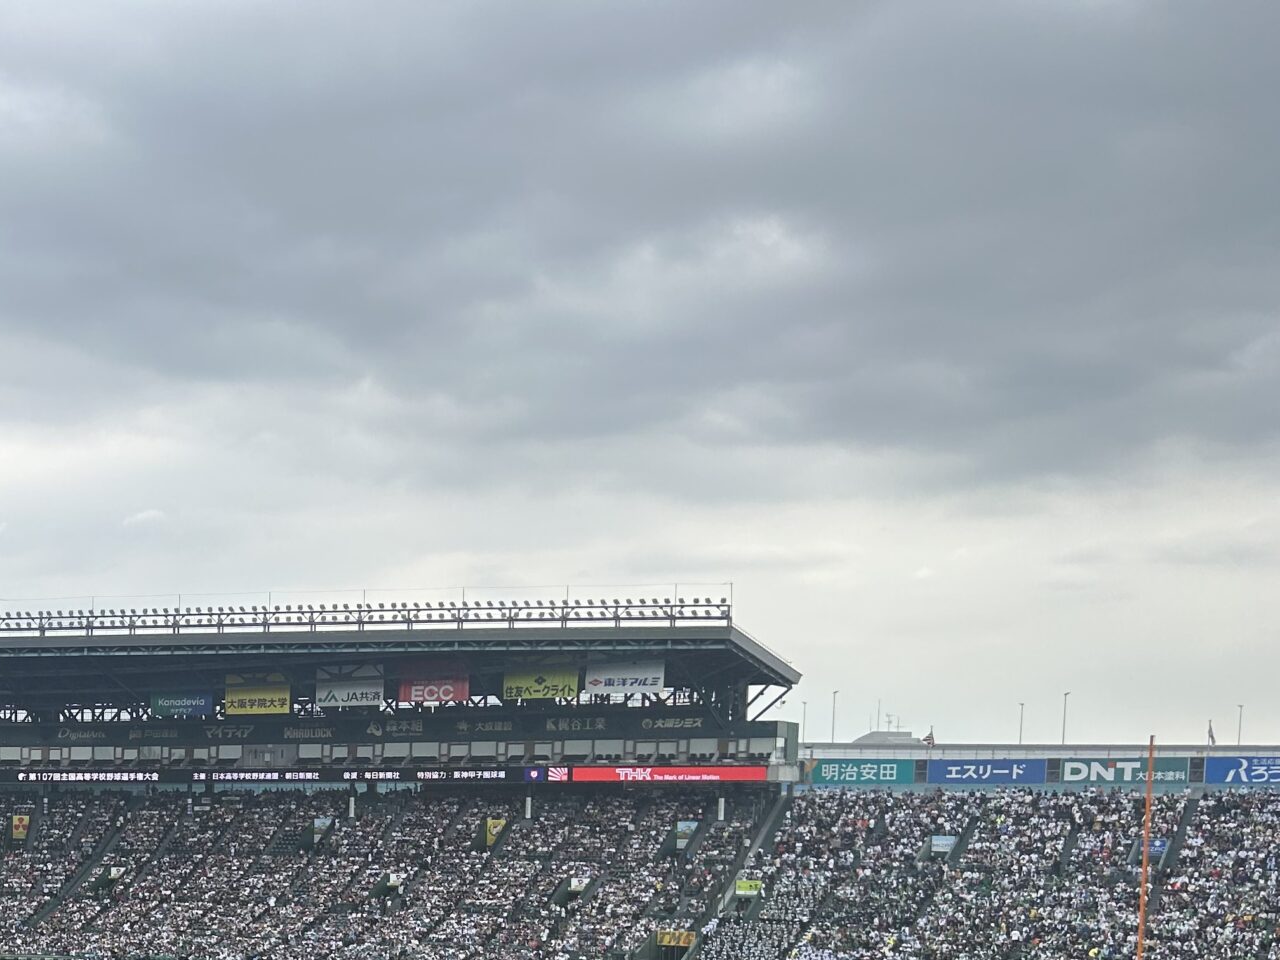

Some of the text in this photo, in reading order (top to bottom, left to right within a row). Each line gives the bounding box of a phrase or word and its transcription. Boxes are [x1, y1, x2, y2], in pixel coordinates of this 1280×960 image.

[604, 677, 661, 688] 東洋アルミ
[410, 685, 454, 701] ECC
[504, 685, 575, 698] 住友ベークライト
[158, 696, 205, 707] Kanadevia
[226, 696, 288, 709] 大阪学院大学
[204, 725, 254, 738] マイティア
[615, 767, 652, 781] THK
[821, 764, 897, 781] 明治安田
[946, 764, 1026, 781] エスリード
[1063, 761, 1186, 782] DNT 大本塗料
